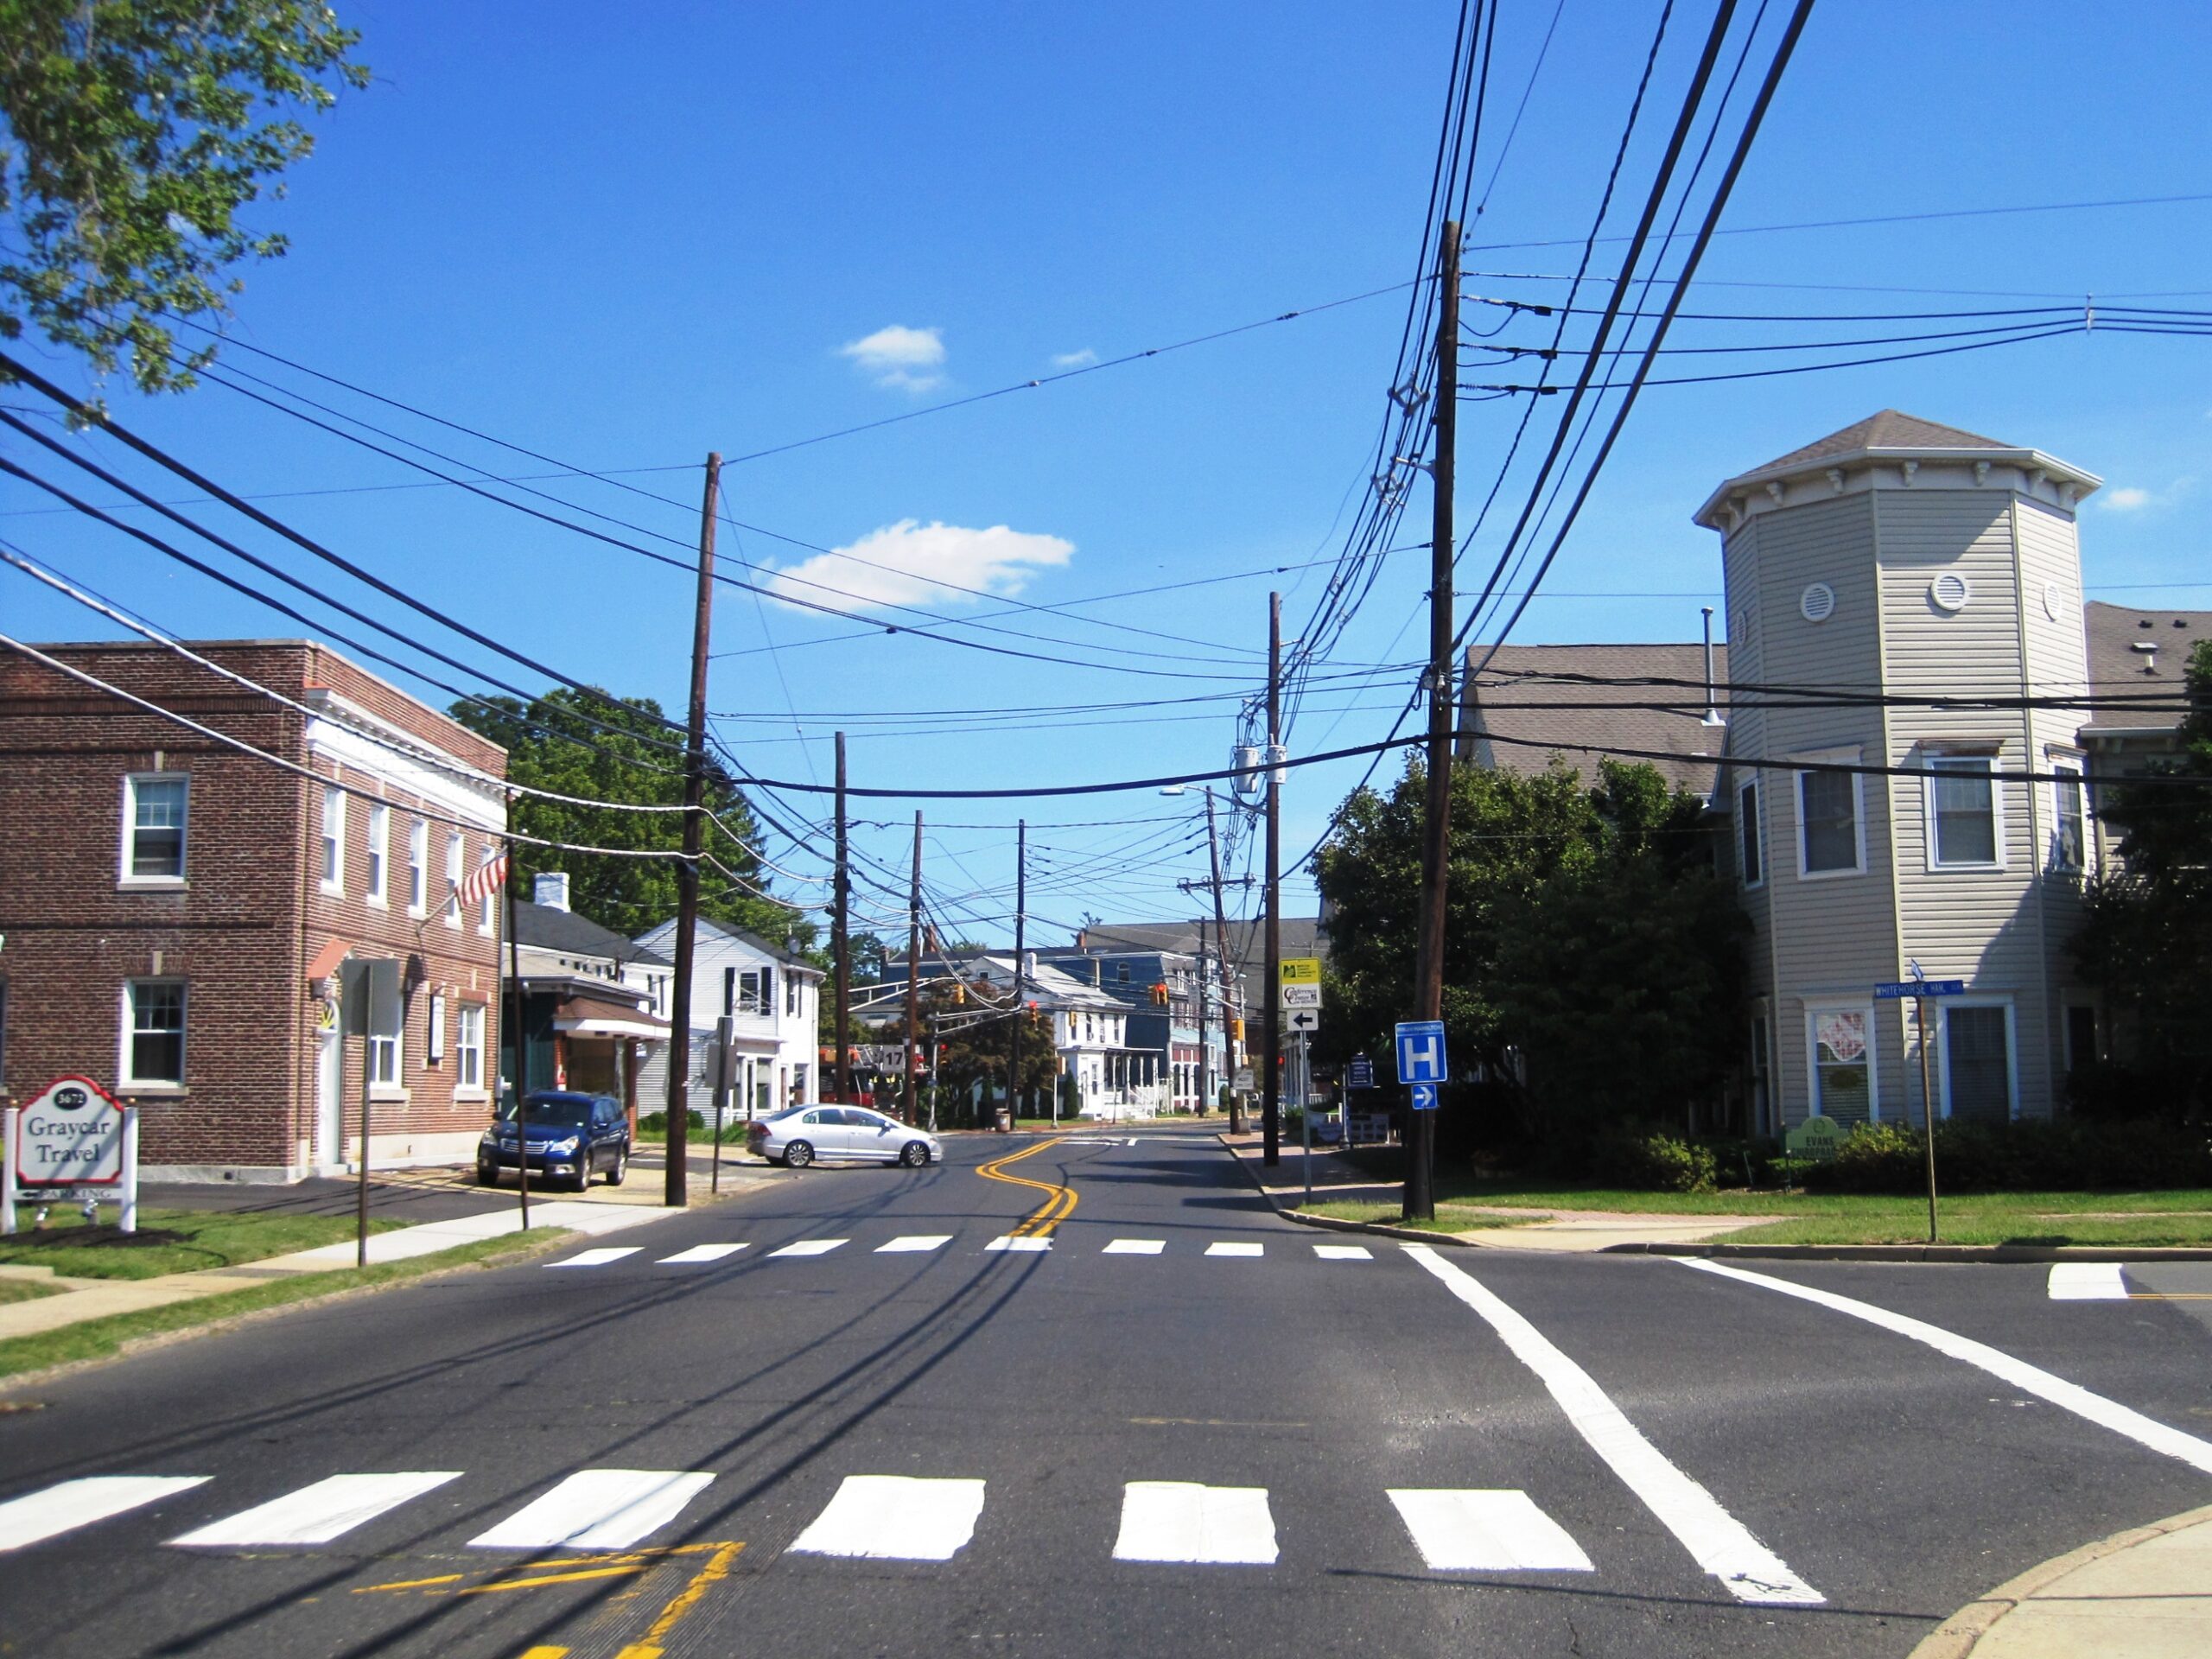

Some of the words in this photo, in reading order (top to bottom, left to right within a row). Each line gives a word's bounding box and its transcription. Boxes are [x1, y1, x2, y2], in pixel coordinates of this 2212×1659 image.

[1876, 984, 1926, 996] WHITEHORSE
[886, 1052, 903, 1065] 17
[1404, 1037, 1439, 1079] H
[58, 1093, 84, 1104] 3672
[29, 1116, 111, 1140] Graycar
[1806, 1136, 1834, 1146] EVANS
[35, 1143, 100, 1162] Travel
[40, 1189, 111, 1198] PARKING
